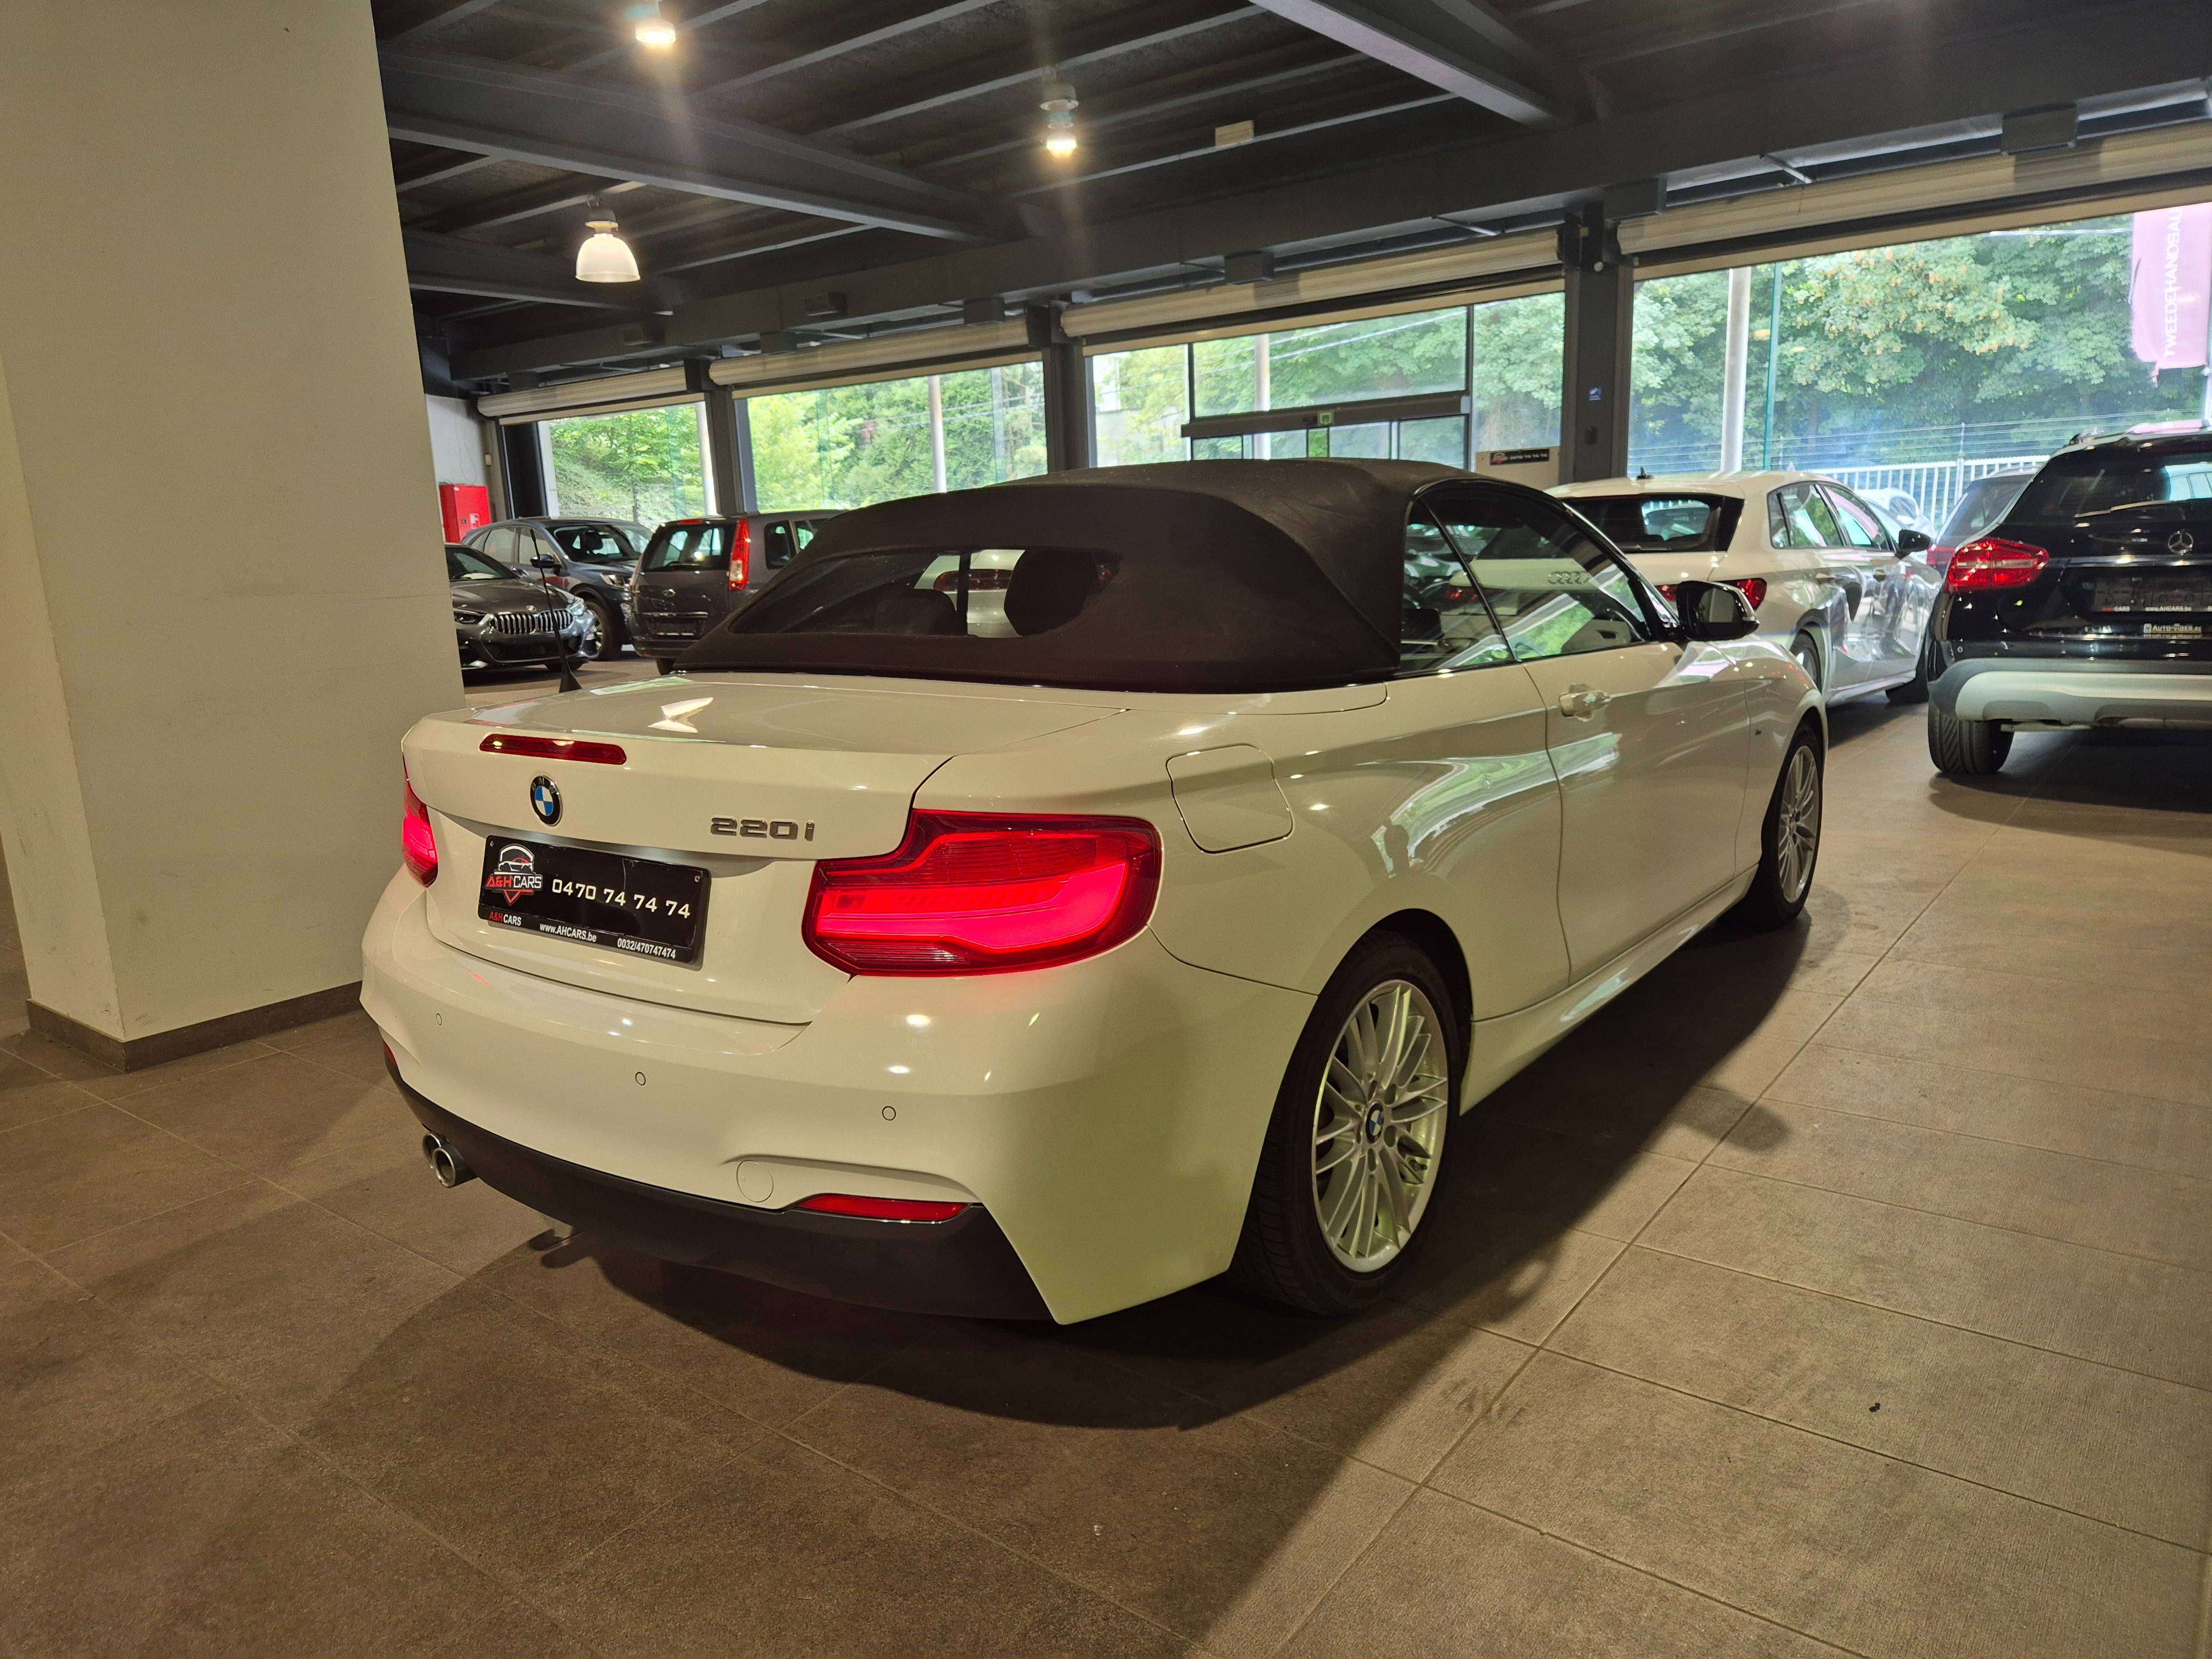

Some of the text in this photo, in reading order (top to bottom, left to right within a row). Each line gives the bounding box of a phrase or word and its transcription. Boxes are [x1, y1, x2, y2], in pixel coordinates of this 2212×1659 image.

[531, 777, 557, 795] BMW
[551, 879, 690, 919] 0470 74 74 74
[503, 914, 522, 926] CARS
[540, 923, 597, 943] www.AHCARS.be
[617, 937, 676, 959] 0032/470747474
